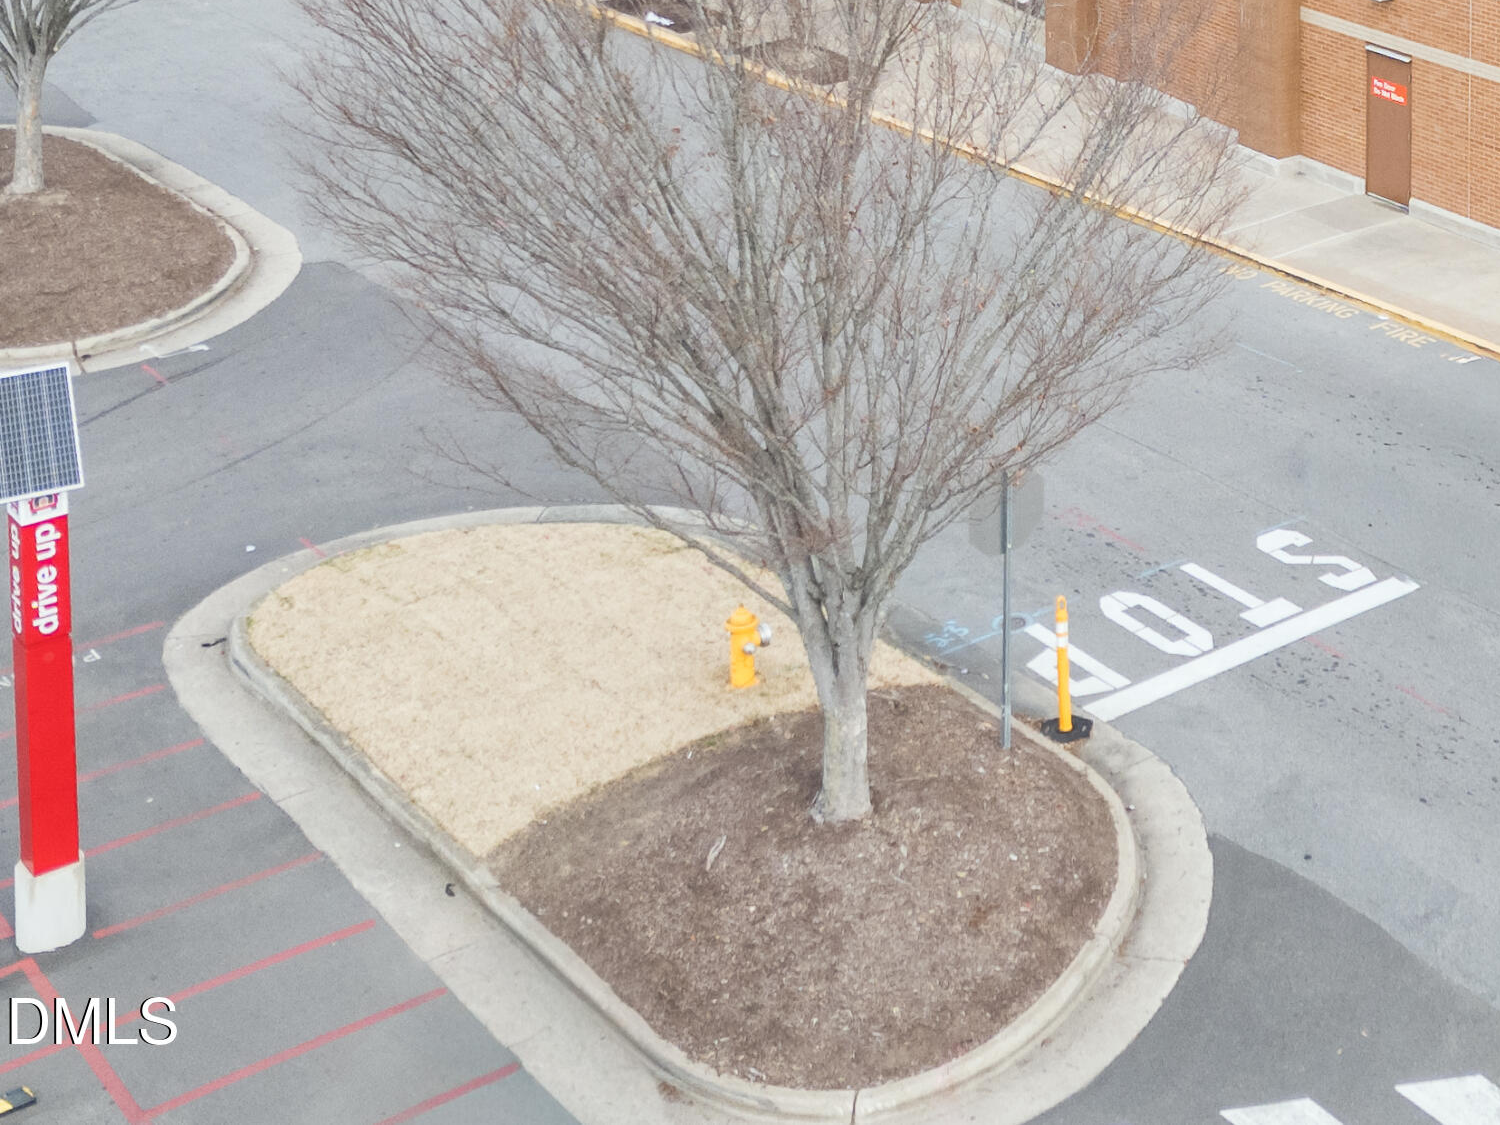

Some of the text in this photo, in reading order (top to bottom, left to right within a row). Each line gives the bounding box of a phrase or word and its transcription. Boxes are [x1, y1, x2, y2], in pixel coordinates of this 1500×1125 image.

[1259, 281, 1359, 320] PARKING
[1368, 320, 1437, 348] FIRE
[10, 524, 22, 634] drive up
[31, 522, 62, 635] drive up
[1025, 528, 1378, 697] STOP
